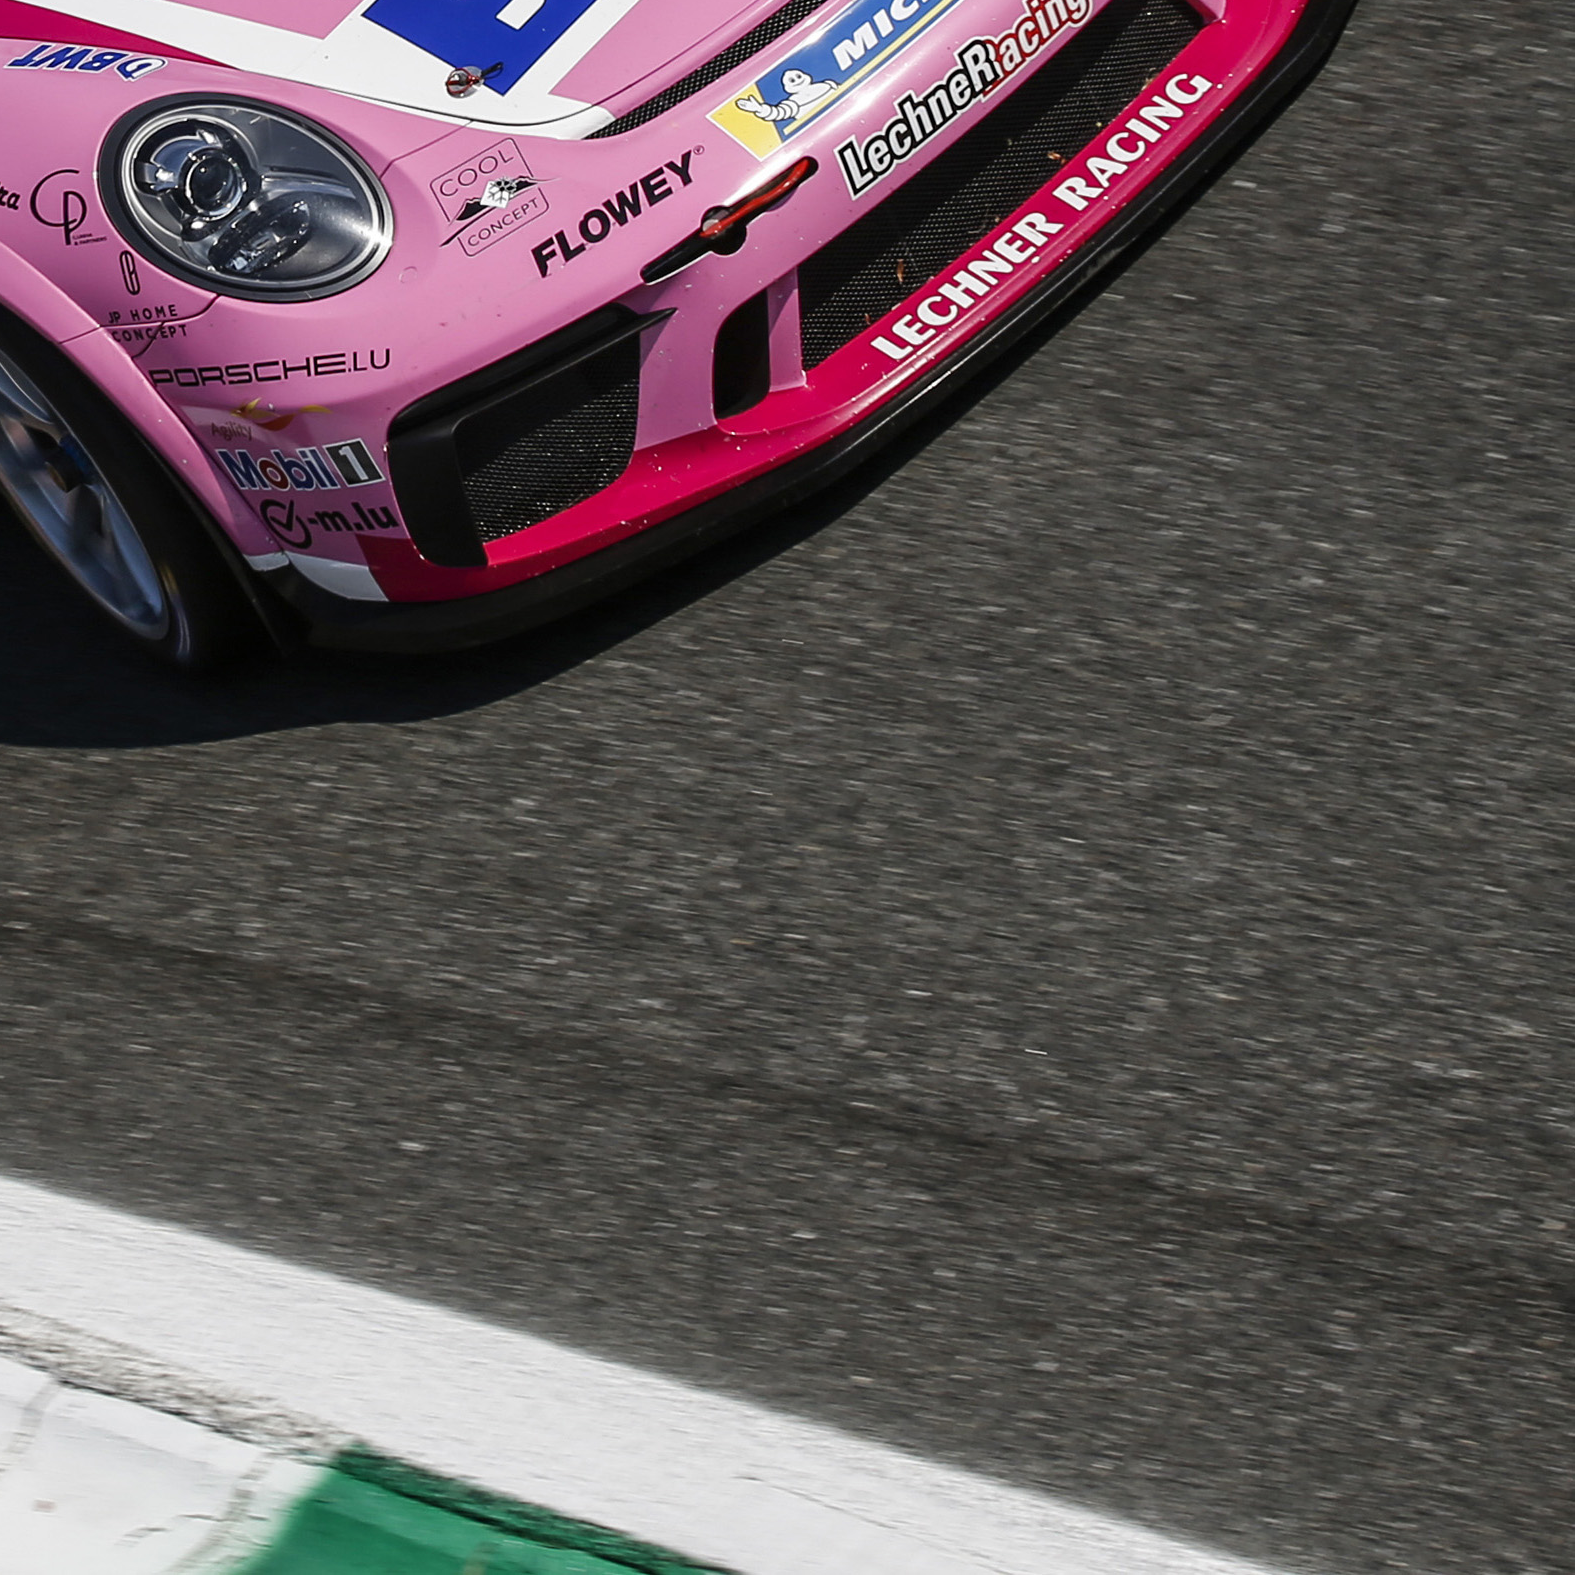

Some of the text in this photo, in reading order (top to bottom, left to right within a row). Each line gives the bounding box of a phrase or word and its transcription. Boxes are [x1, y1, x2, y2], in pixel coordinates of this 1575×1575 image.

[4, 43, 132, 73] BWT
[439, 150, 514, 197] COOL
[467, 198, 539, 247] CONCEPT
[870, 72, 1212, 363] LECHNER RACING
[108, 304, 178, 324] JP HOME
[112, 325, 187, 342] CONCEPT
[147, 348, 390, 387] PORSCHE.LU
[211, 422, 252, 441] Agility
[215, 442, 376, 492] Mobil 1
